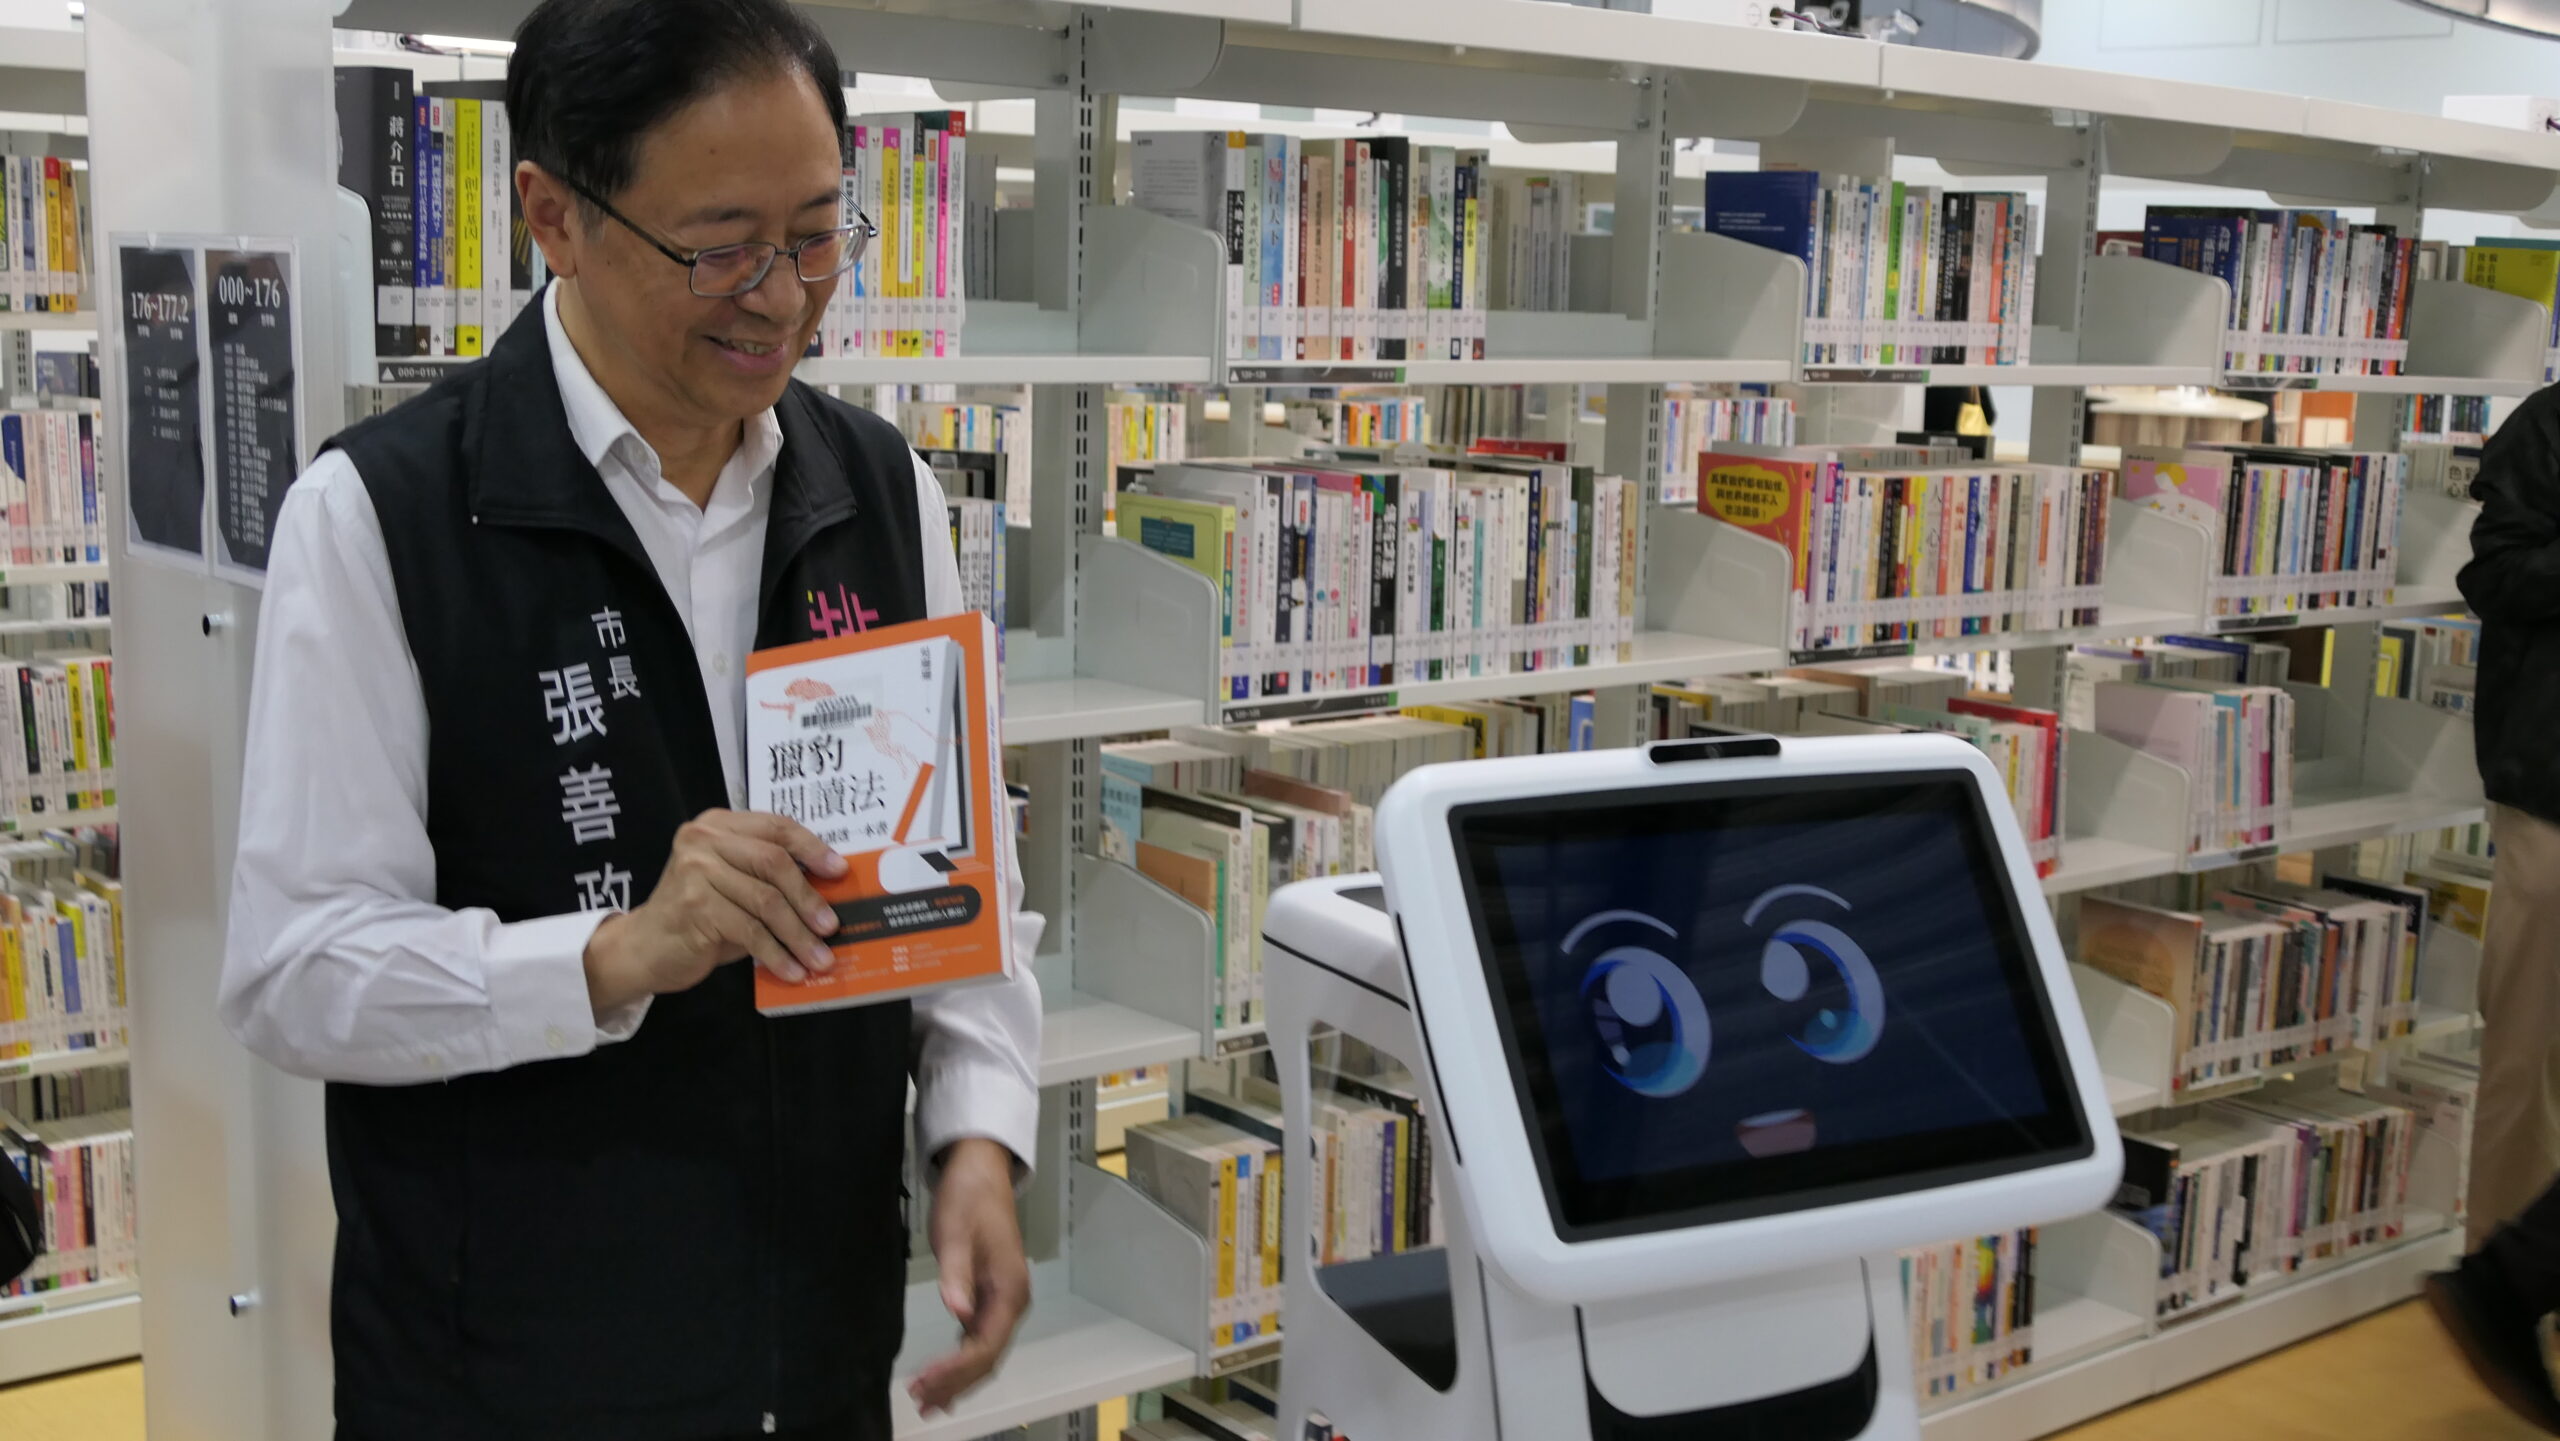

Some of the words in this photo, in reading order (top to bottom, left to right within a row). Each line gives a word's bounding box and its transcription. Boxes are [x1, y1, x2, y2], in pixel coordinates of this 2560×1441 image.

[388, 115, 406, 188] 蔣介石
[464, 175, 479, 241] 創作的基因
[131, 291, 190, 324] 176~177.2
[218, 274, 281, 310] 000~176
[590, 605, 642, 700] 市長
[538, 662, 634, 913] 張善政
[767, 733, 843, 783] 獵豹
[769, 769, 886, 823] 閱讀法
